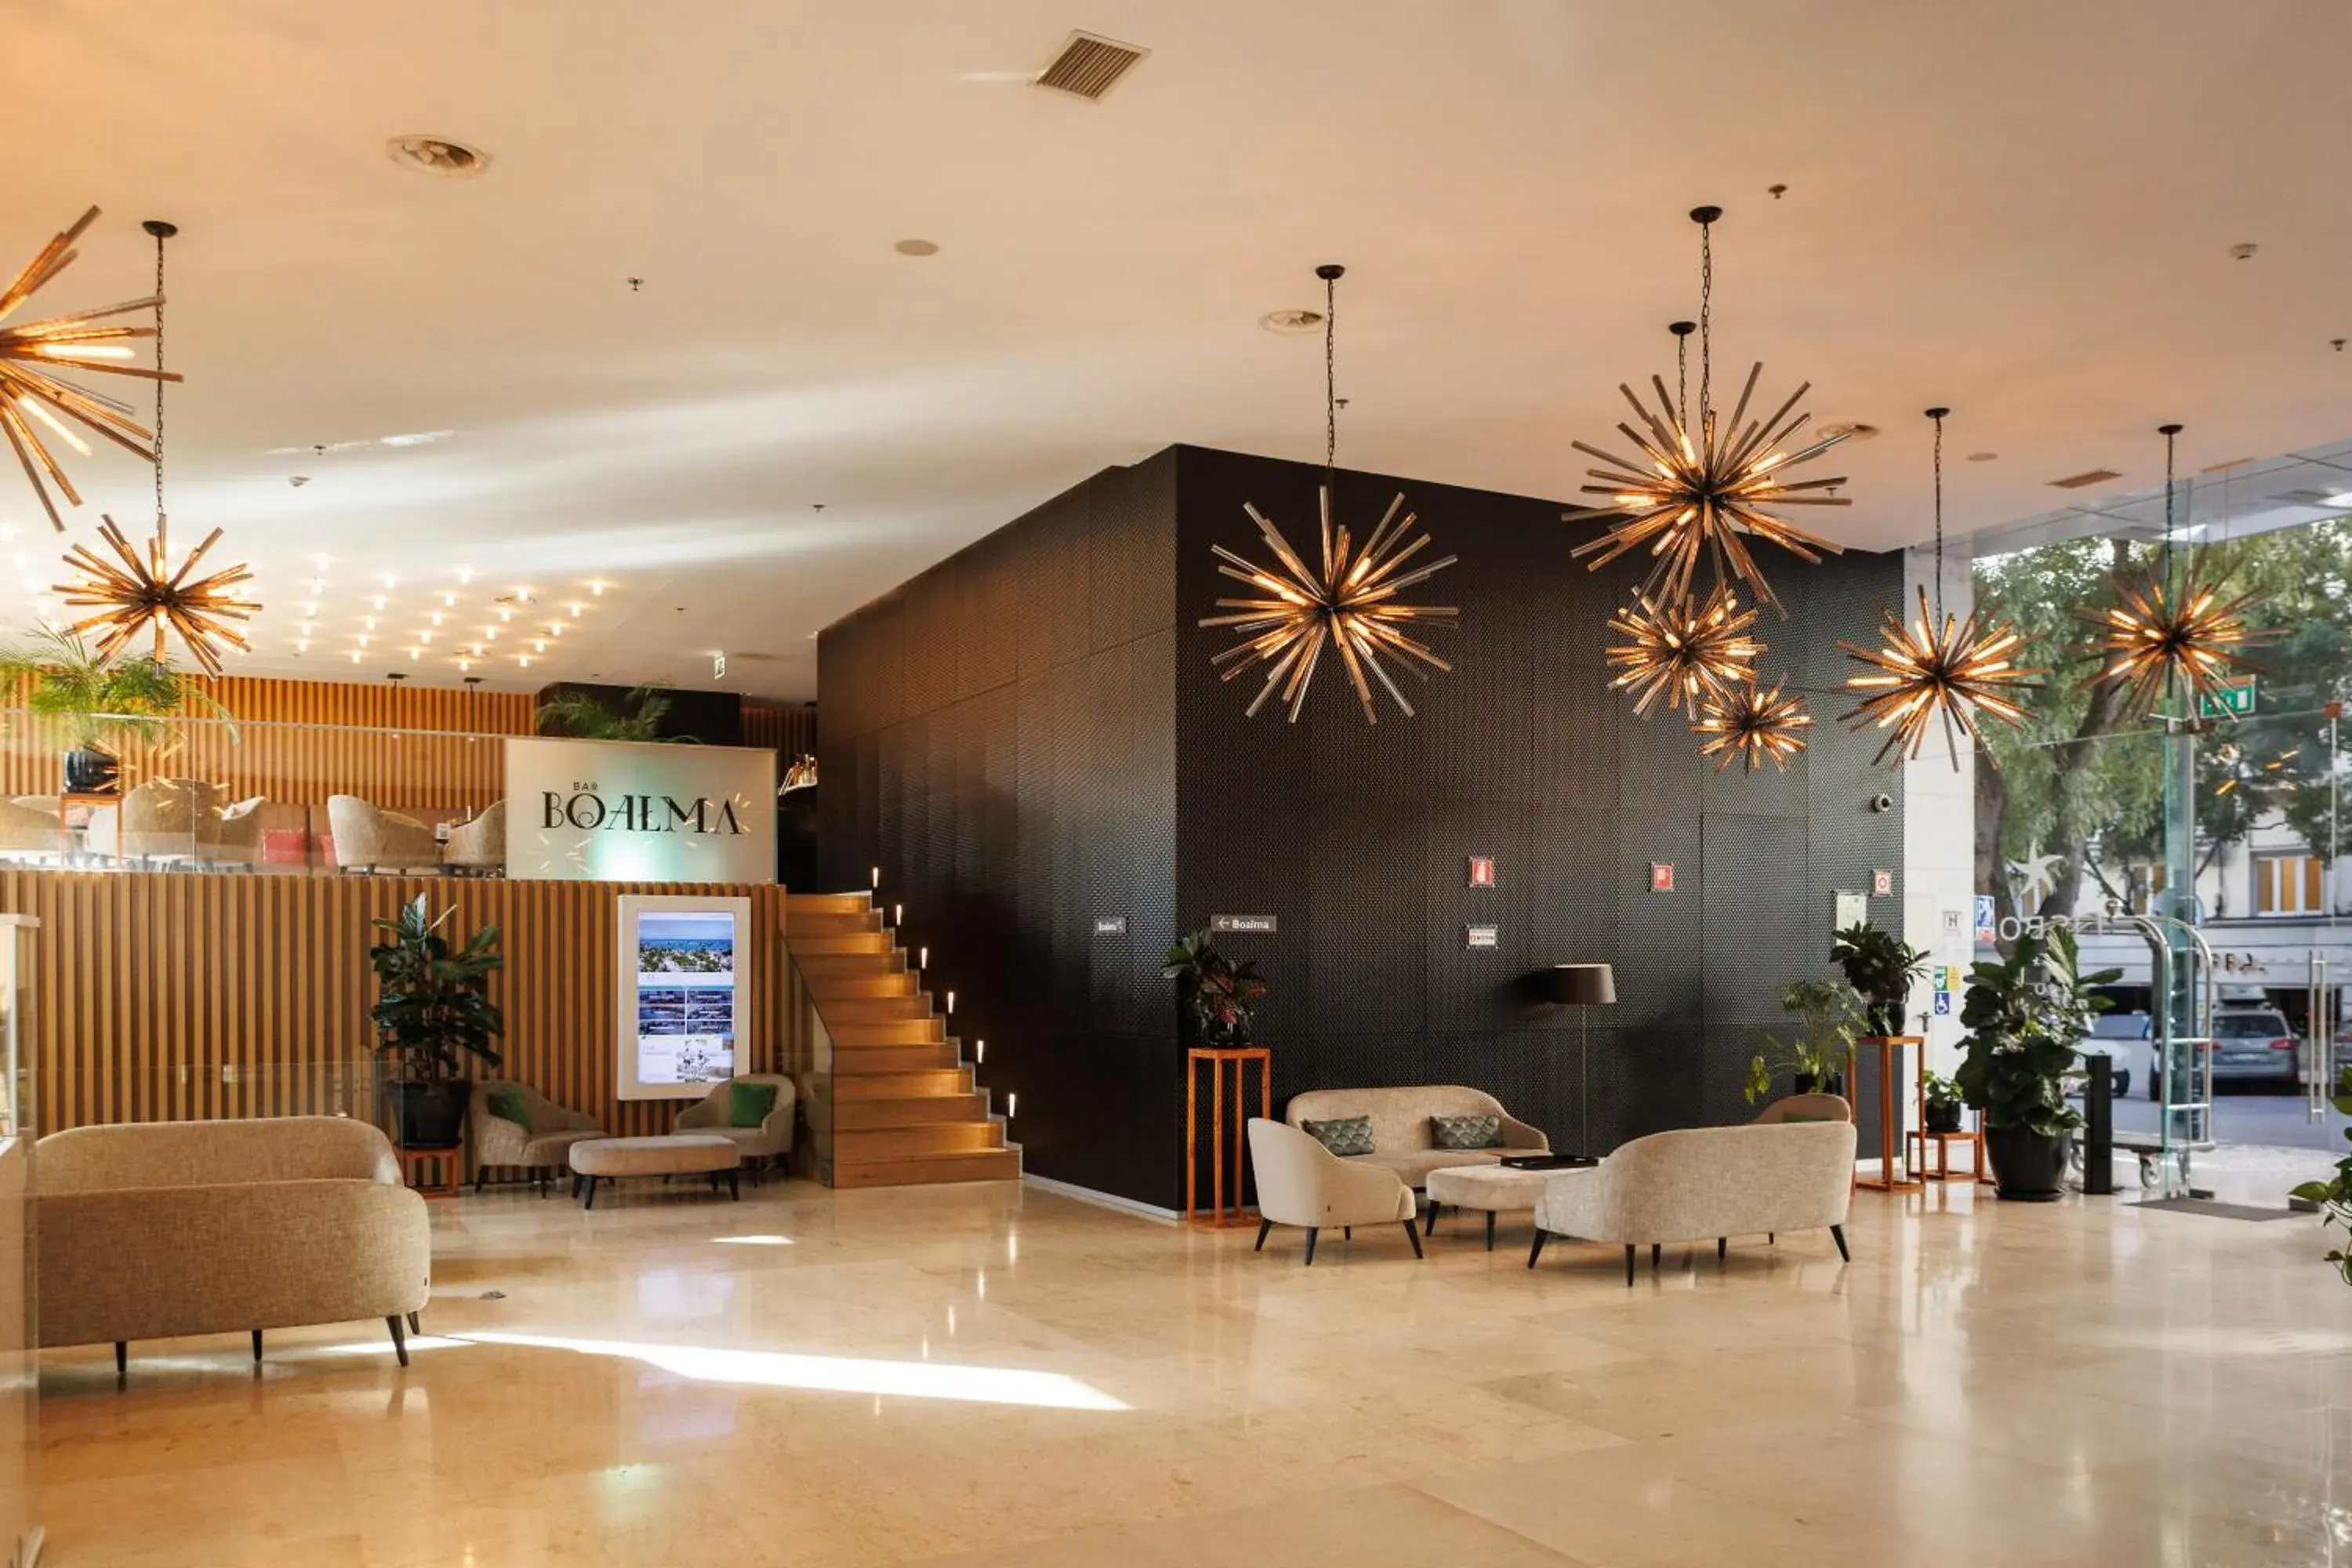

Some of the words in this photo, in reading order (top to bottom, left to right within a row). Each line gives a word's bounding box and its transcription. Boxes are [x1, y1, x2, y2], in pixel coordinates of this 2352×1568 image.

[573, 781, 598, 791] BAR
[541, 791, 742, 835] BOALMA
[1232, 919, 1269, 929] Boalma
